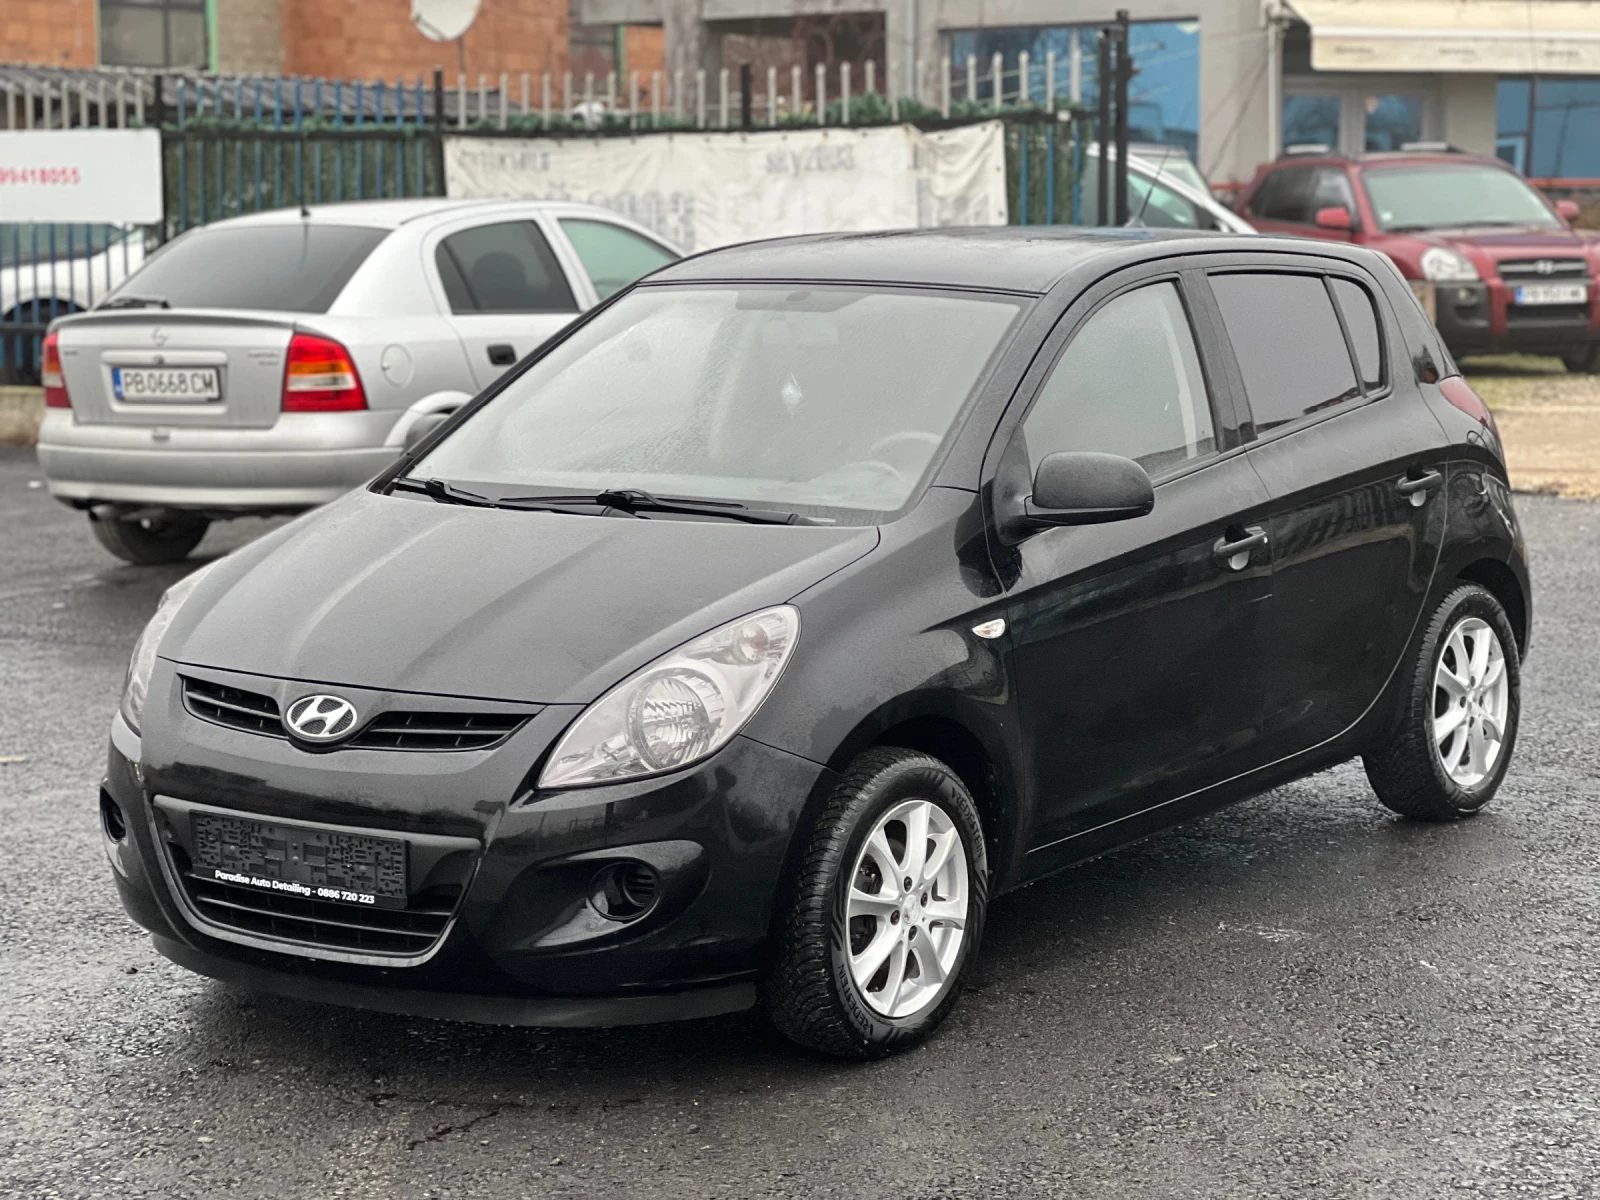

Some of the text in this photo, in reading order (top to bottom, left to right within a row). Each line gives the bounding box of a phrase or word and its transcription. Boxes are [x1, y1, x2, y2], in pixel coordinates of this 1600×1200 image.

[214, 869, 250, 885] Paradise
[250, 876, 271, 888] Auto
[272, 880, 311, 896] Detailing
[317, 887, 341, 900] 0886
[341, 891, 358, 902] 720
[358, 893, 375, 904] 223
